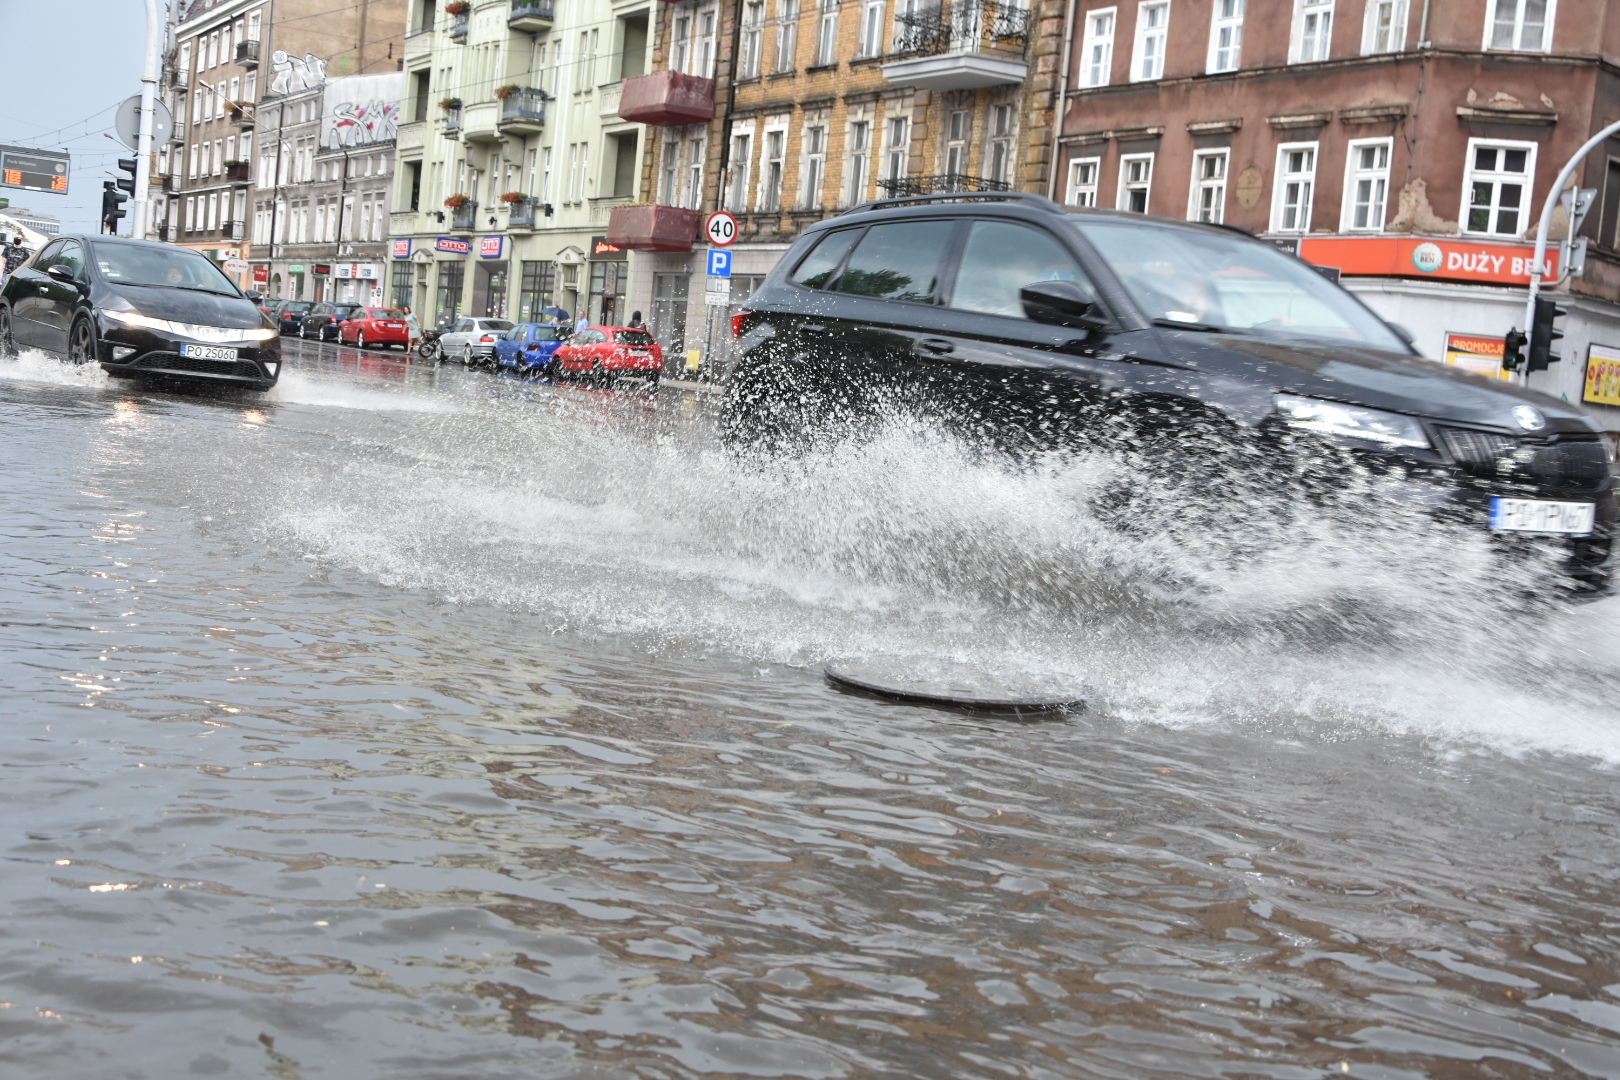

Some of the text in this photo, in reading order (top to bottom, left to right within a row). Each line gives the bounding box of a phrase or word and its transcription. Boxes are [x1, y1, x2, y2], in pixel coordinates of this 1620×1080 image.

[710, 220, 733, 238] 40
[394, 241, 408, 251] OTTO
[439, 241, 467, 250] OTTO
[481, 240, 499, 251] OTTO
[711, 252, 727, 274] P
[1447, 250, 1552, 278] DUŻY BEN
[187, 345, 235, 360] PO 2S060
